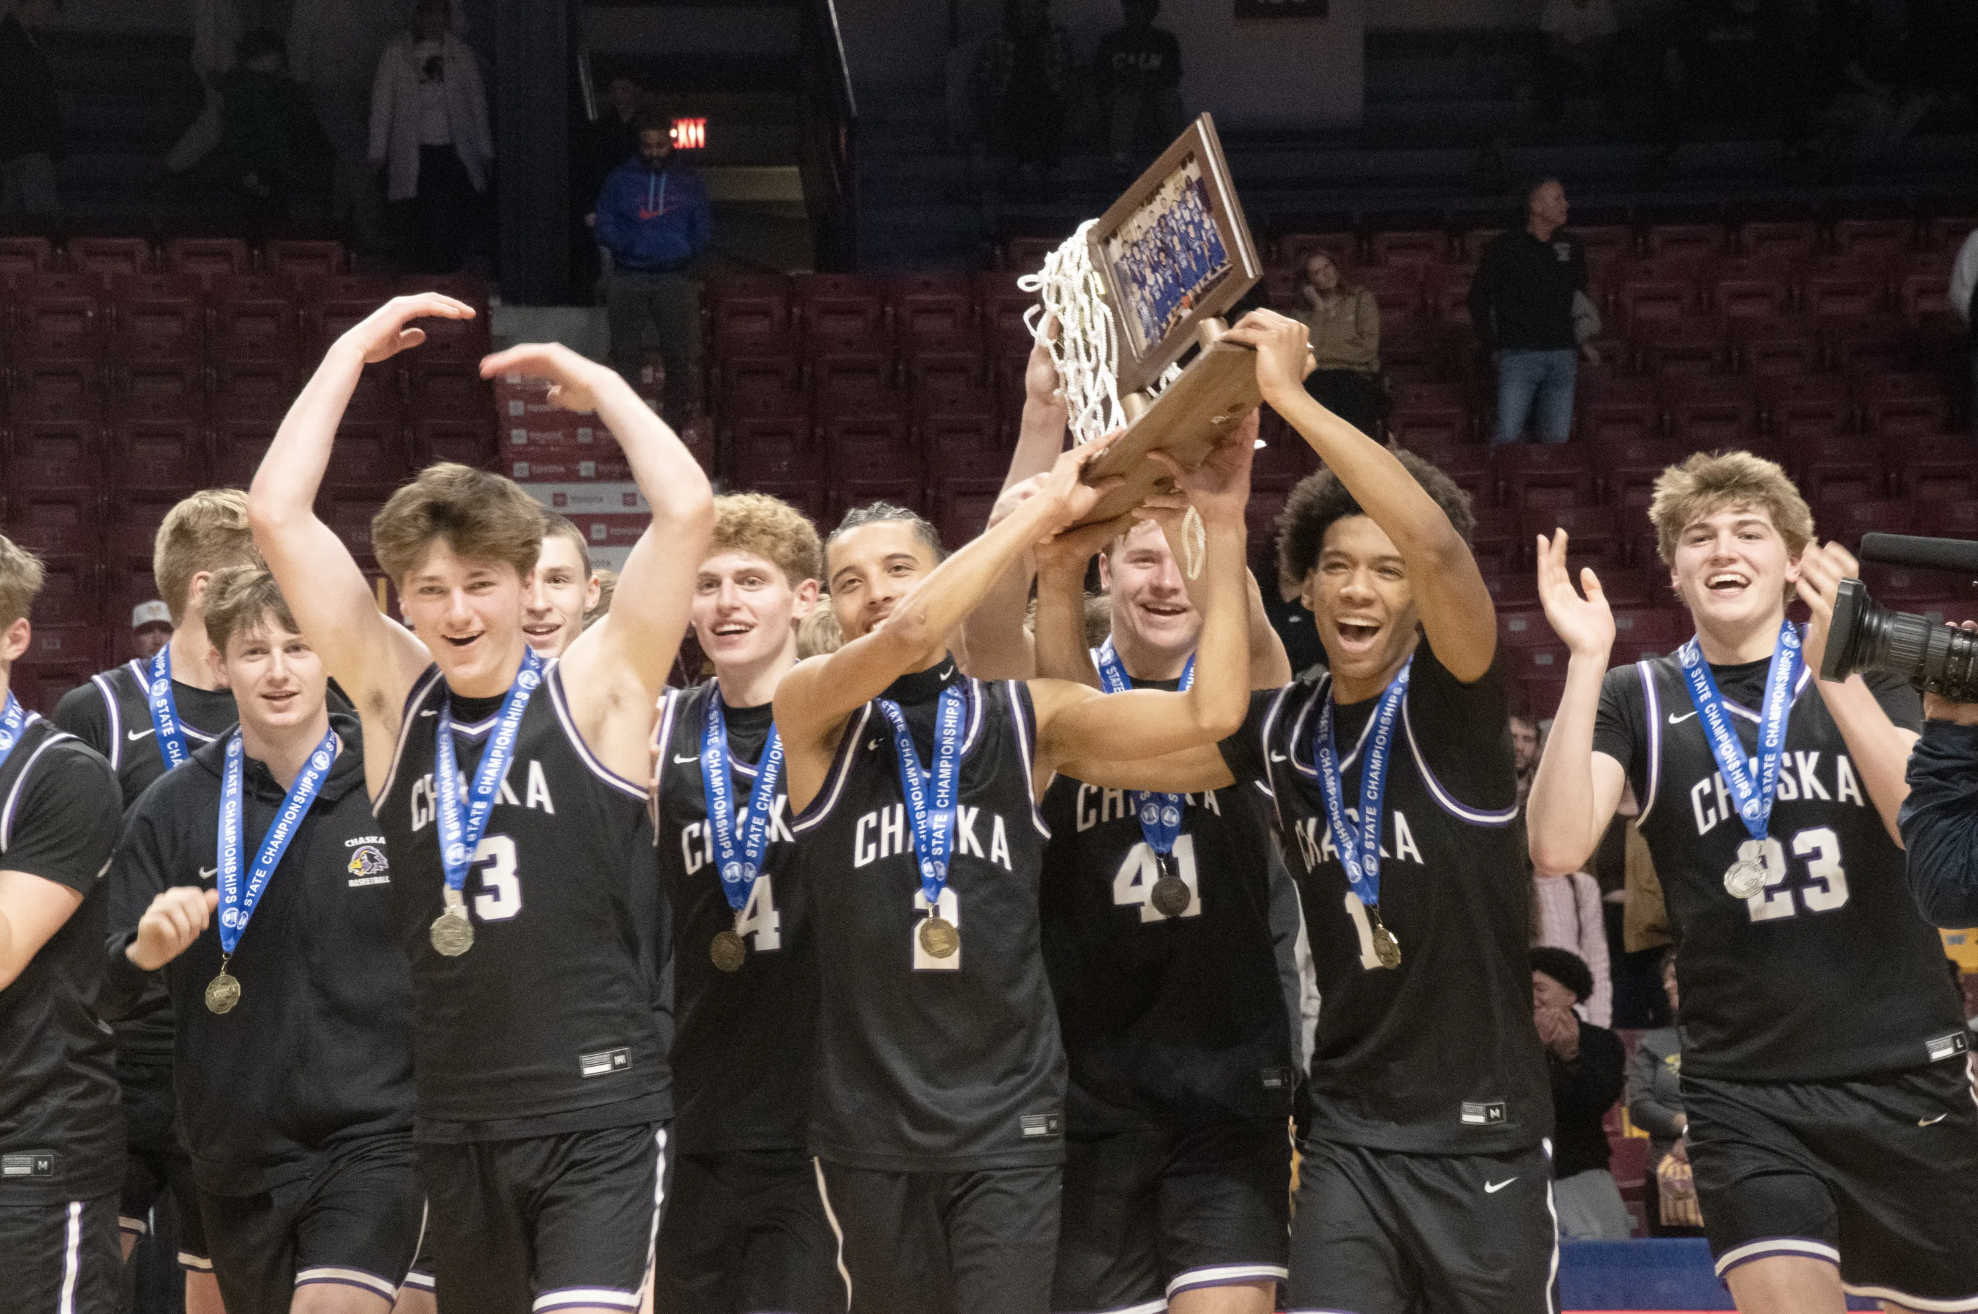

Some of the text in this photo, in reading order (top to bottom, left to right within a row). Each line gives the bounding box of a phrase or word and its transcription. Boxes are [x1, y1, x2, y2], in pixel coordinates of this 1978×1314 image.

[156, 698, 175, 737] STATE
[1691, 668, 1753, 800] STATE CHAMPIONSHIPS
[1763, 649, 1796, 794] STATE CHAMPIONSHIPS
[411, 760, 556, 832] CHKA
[466, 691, 530, 842] STATE CHAMPIONSHIPS
[707, 750, 735, 860] CHAMPIONSHIPS
[745, 734, 784, 858] STATE CHAMPION
[932, 698, 960, 856] STATE CHAMPIONSHIPS
[1364, 686, 1404, 850] STATE CHAMPIONSHIPS
[1690, 750, 1866, 836] CHSKA
[224, 759, 239, 904] STATE CHAMPIONSHIPS
[243, 769, 320, 907] STATE CHAMPIONSHIPS
[344, 835, 387, 848] CHASKA
[854, 803, 1013, 872] CHKA
[1113, 833, 1202, 924] 41
[1737, 827, 1849, 923] 23
[736, 873, 782, 952] 4
[1344, 891, 1385, 971] 1
[38, 1160, 48, 1171] M
